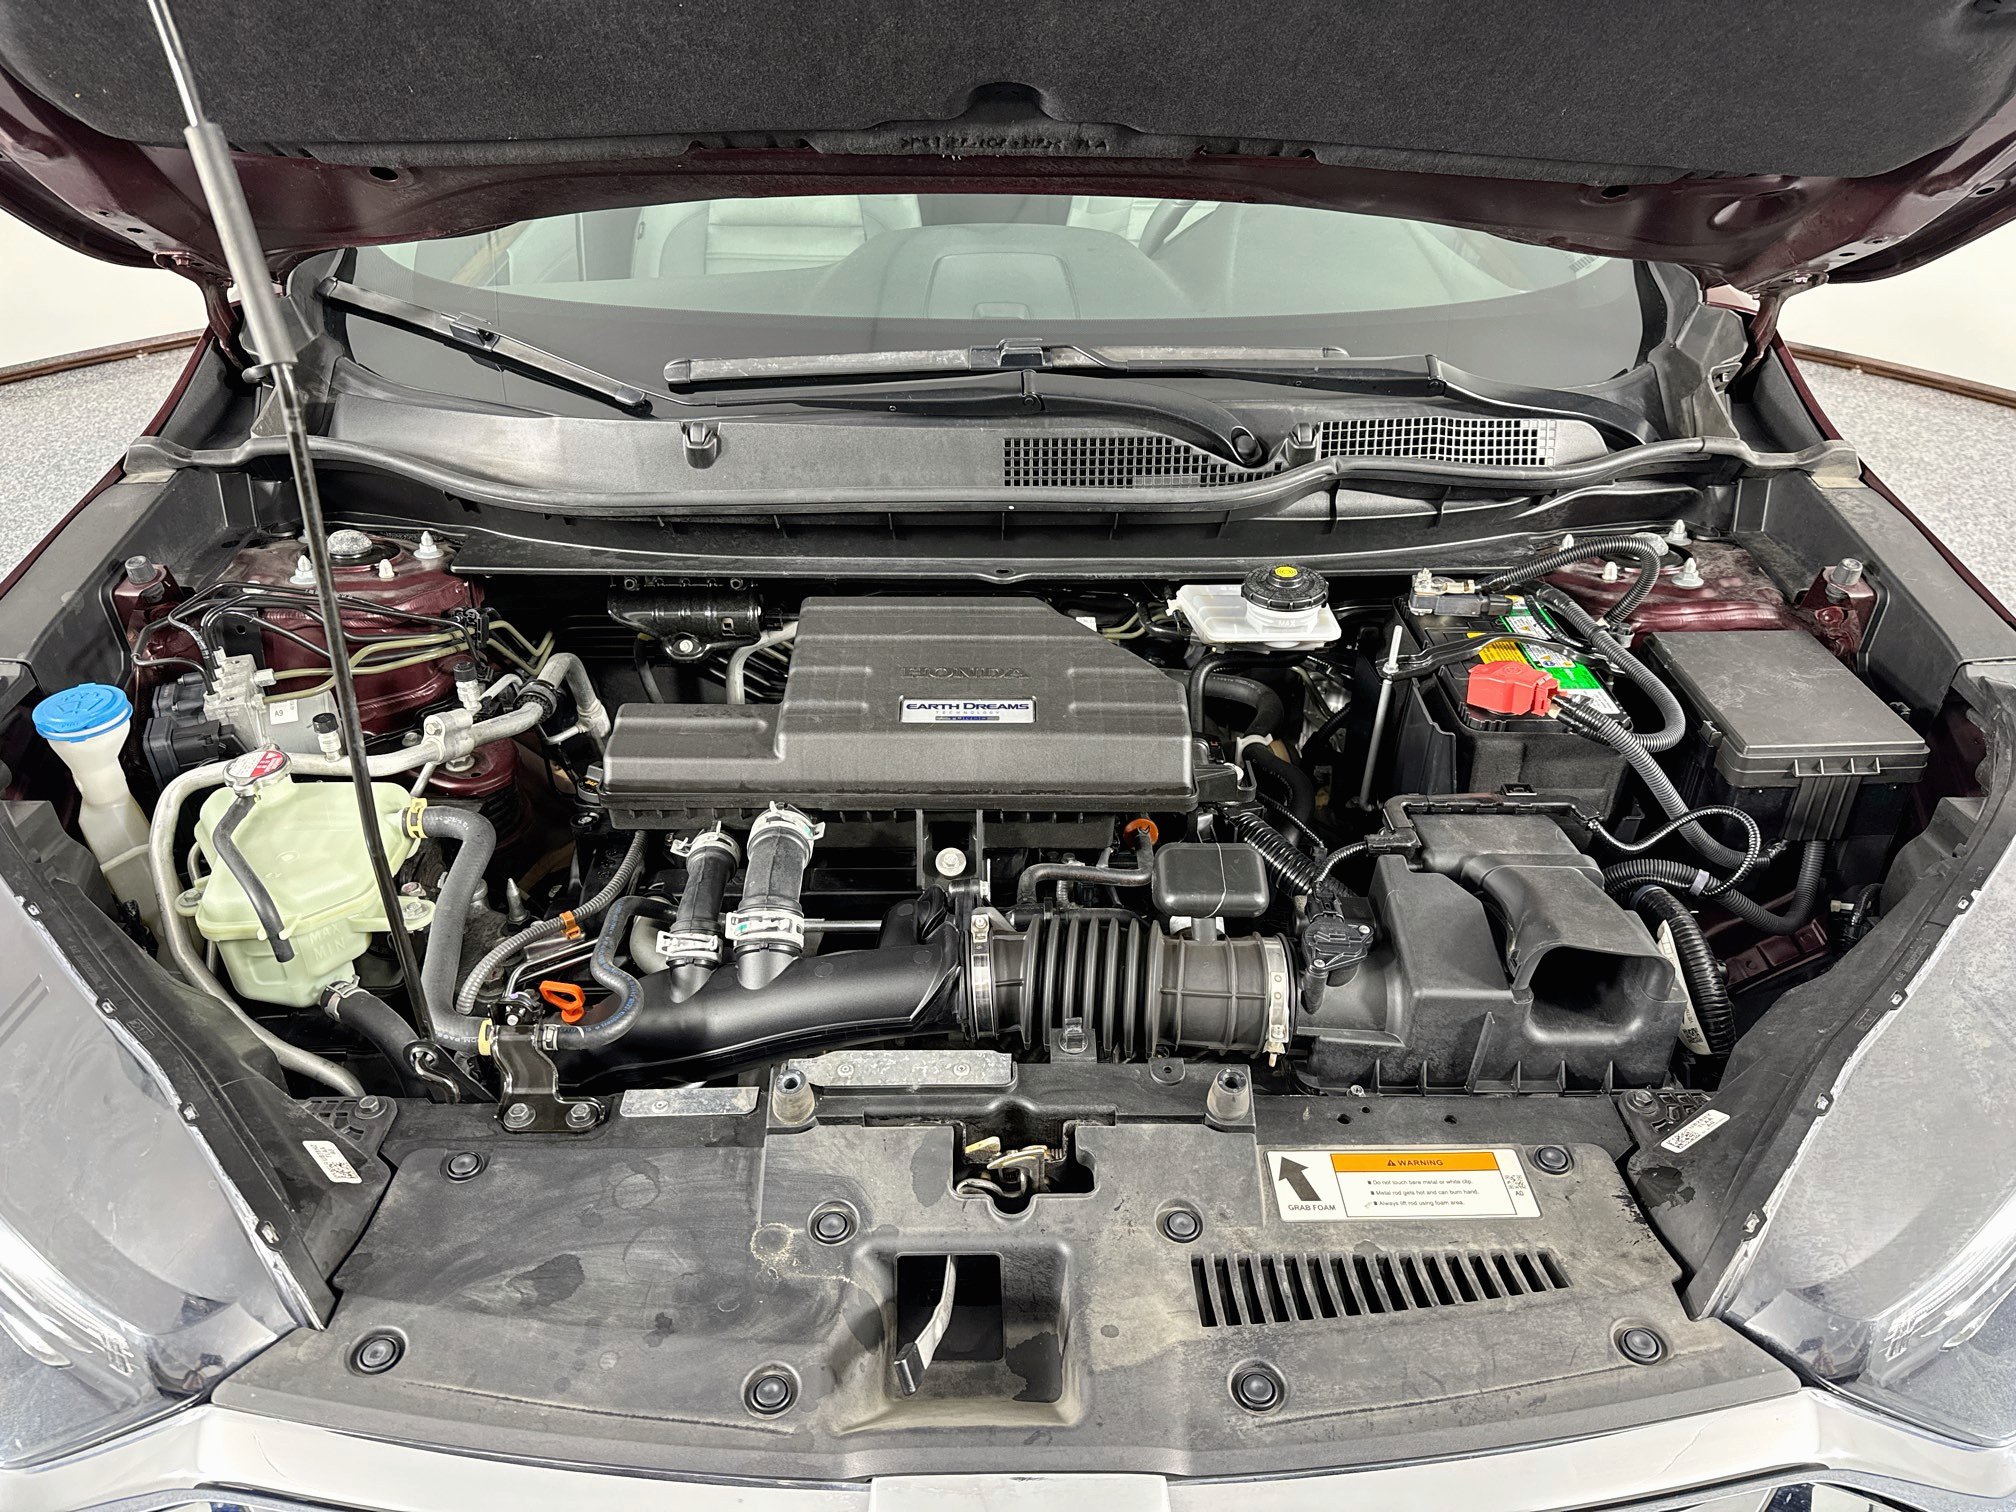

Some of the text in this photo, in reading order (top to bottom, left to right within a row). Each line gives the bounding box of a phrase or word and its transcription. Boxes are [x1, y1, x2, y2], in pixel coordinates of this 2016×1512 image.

[1278, 620, 1296, 628] MAX
[901, 666, 1032, 680] HONDA
[309, 924, 342, 944] MAX
[312, 938, 346, 960] MIN
